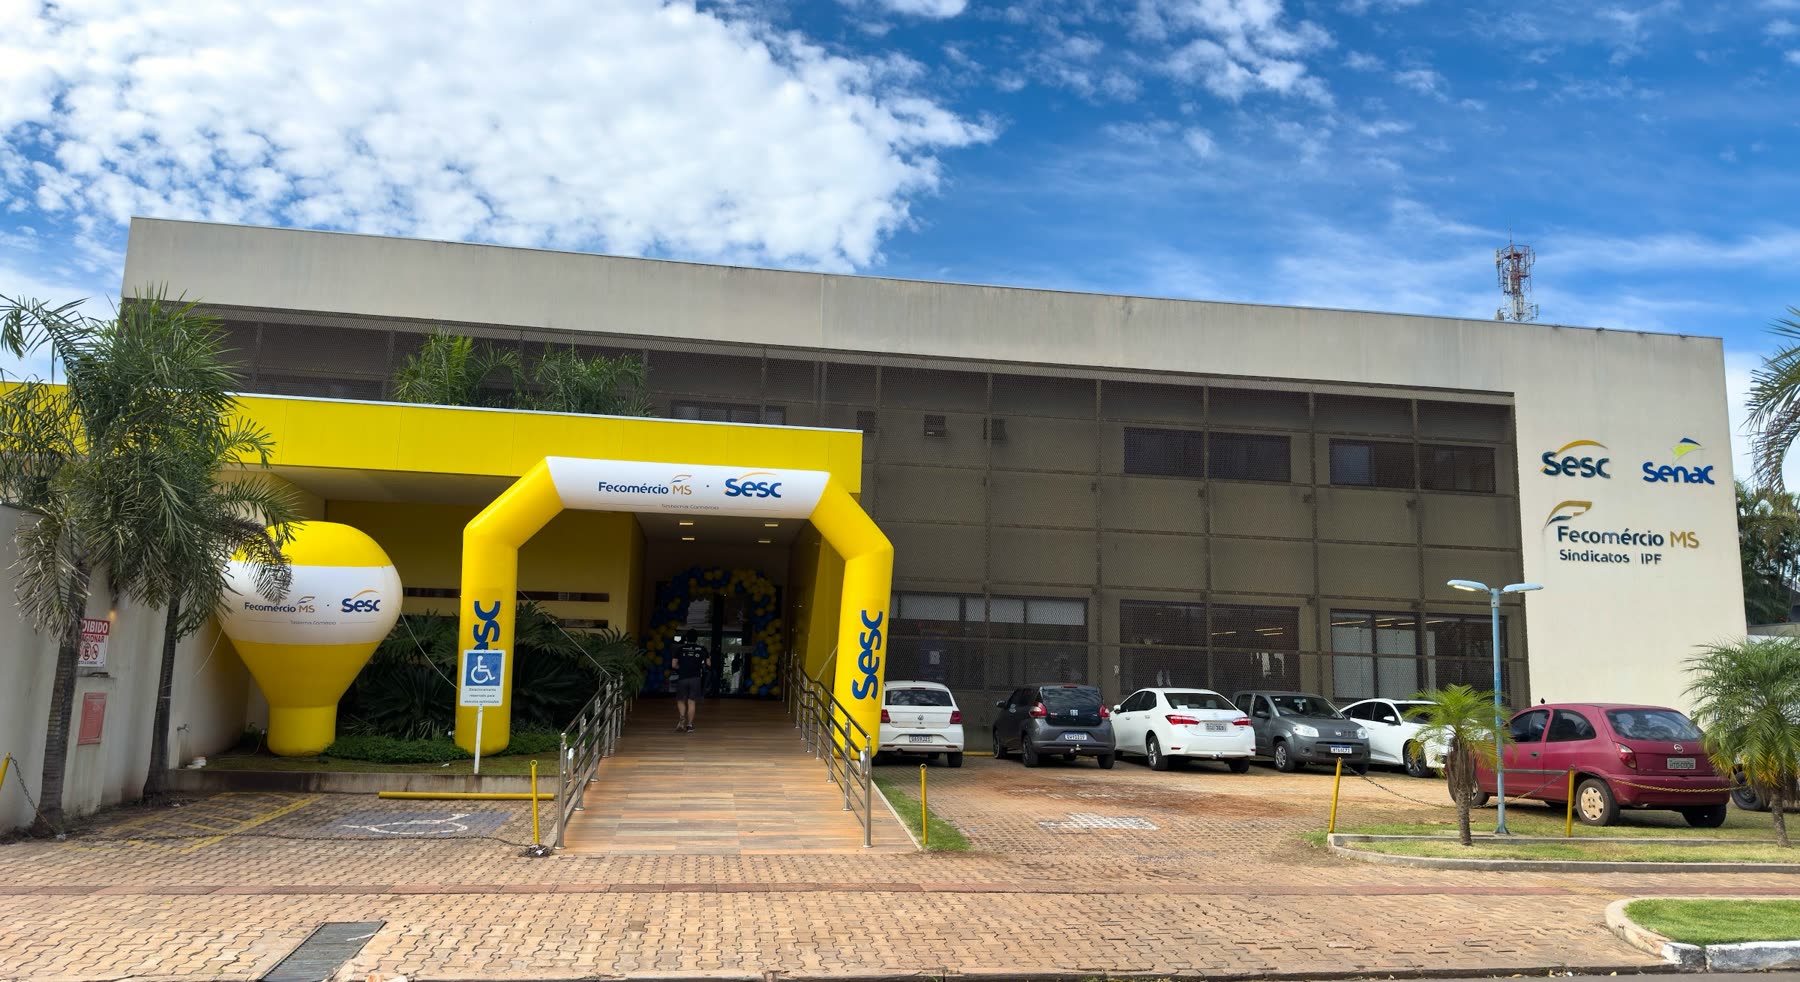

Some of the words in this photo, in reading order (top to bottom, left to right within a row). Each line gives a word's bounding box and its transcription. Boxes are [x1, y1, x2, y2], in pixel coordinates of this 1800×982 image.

[1541, 451, 1611, 480] Sesc
[1642, 461, 1715, 485] Senac
[598, 481, 669, 495] Fecomércio
[672, 485, 692, 496] MS
[724, 478, 782, 498] Sesc
[1557, 525, 1665, 547] Fecomércio
[1670, 531, 1700, 549] MS
[1559, 549, 1630, 564] Sindicatos
[1641, 553, 1662, 565] IPF
[244, 602, 297, 613] Fecomércio
[341, 598, 381, 613] Sesc
[82, 620, 109, 634] OIBIDO
[473, 600, 501, 651] sc
[852, 609, 883, 700] Sesc
